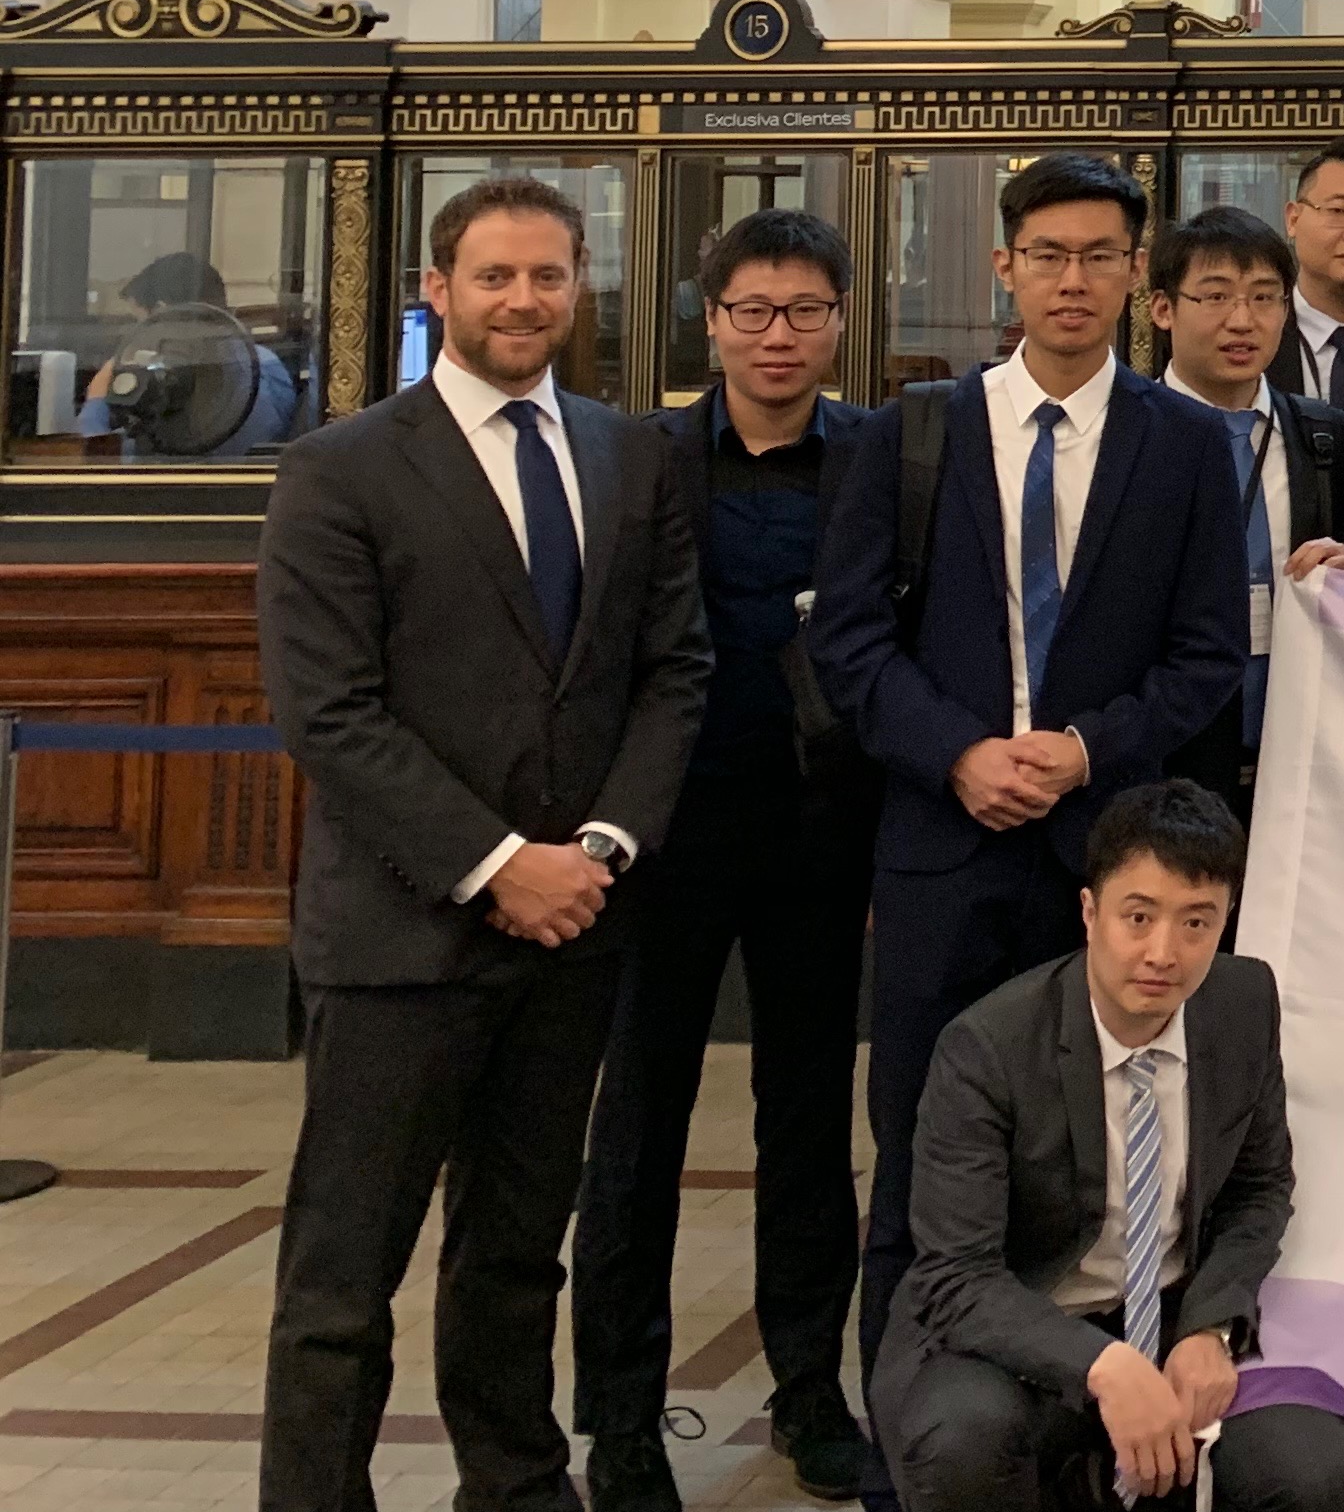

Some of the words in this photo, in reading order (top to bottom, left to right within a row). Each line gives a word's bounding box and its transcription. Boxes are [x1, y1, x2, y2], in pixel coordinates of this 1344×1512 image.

[744, 14, 769, 39] 15
[705, 113, 780, 128] Exclusiva
[783, 112, 852, 127] Clientes
